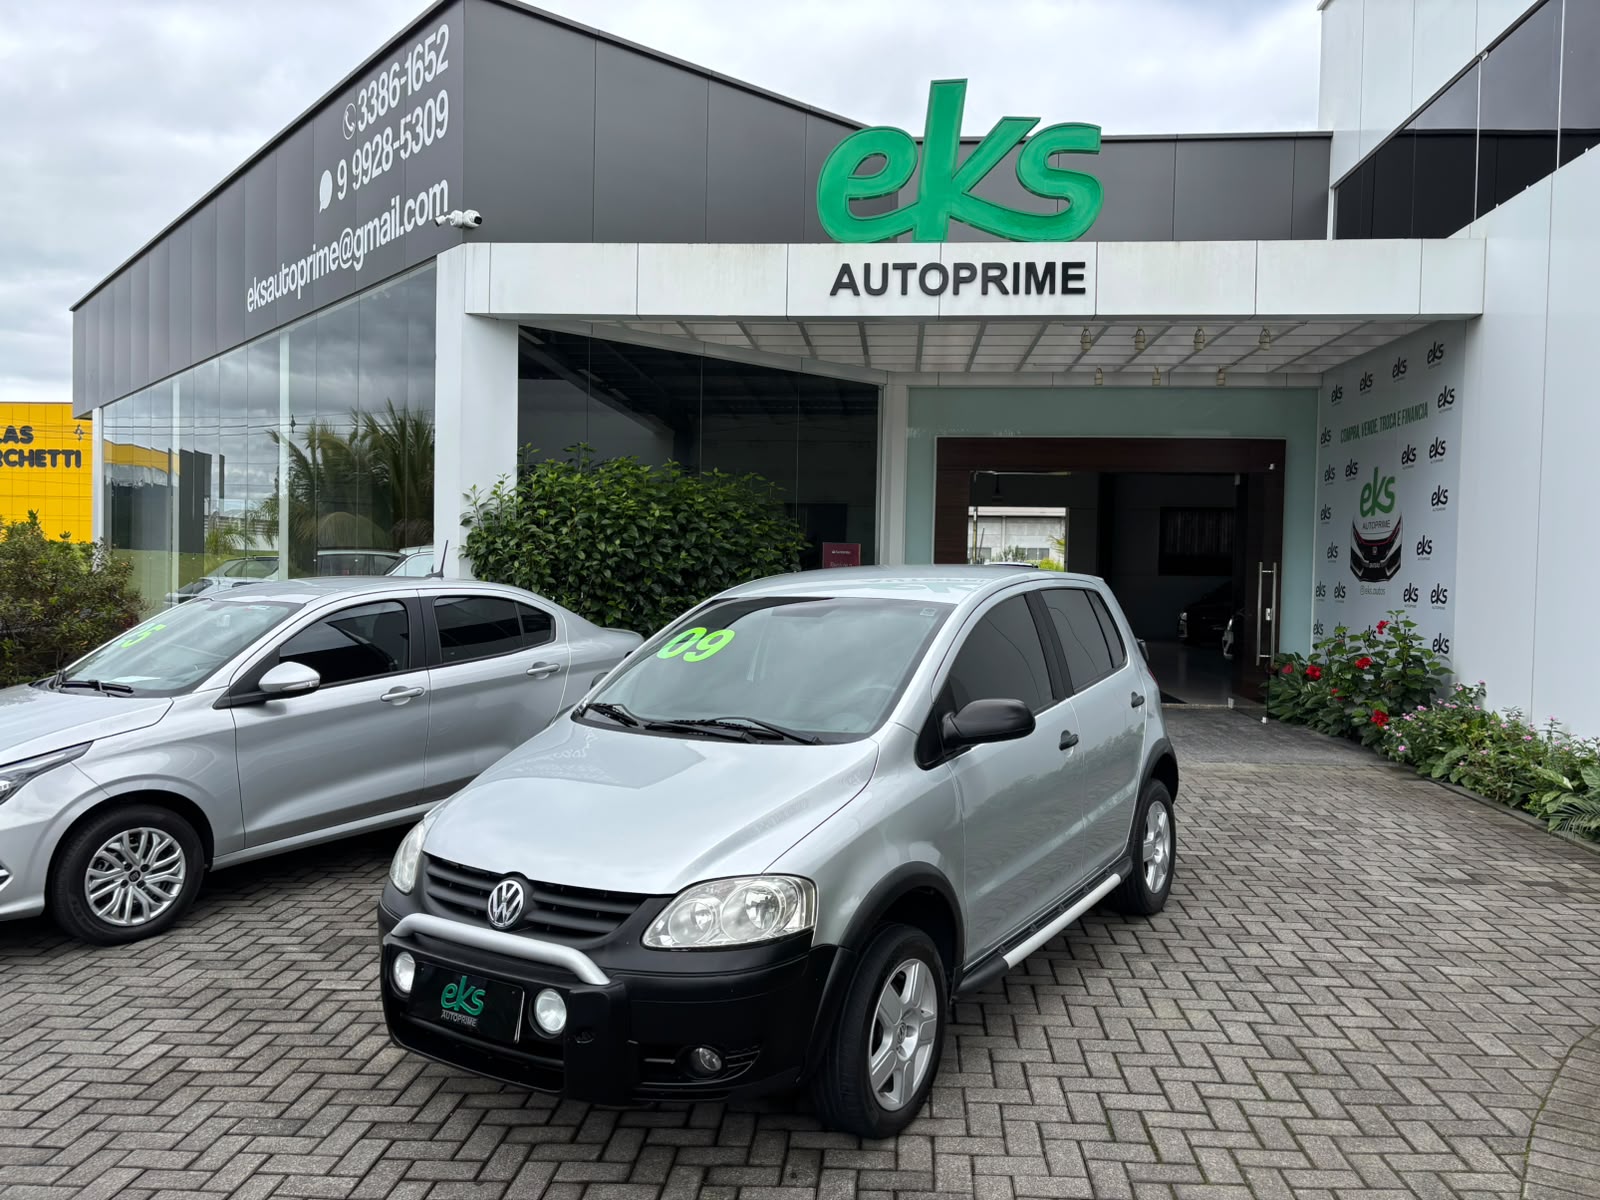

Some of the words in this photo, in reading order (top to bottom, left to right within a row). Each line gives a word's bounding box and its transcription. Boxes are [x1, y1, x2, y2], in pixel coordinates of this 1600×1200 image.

[357, 23, 449, 133] 3386-1652
[336, 158, 348, 201] 9
[352, 89, 449, 190] 9928-5309
[816, 78, 1104, 243] eks
[247, 179, 449, 313] eksautoprime@gmail.com
[829, 261, 1086, 296] AUTOPRIME
[1427, 341, 1444, 364] eks
[1392, 357, 1407, 378] eks
[1359, 371, 1373, 392] eks
[1331, 384, 1343, 403] eks
[1437, 385, 1455, 408] eks
[1380, 412, 1396, 432] TROCA
[1397, 410, 1402, 427] E
[1402, 402, 1428, 424] FINANCIA
[0, 448, 81, 468] CHETTI
[1401, 444, 1417, 465] eks
[1429, 436, 1446, 459] eks
[1345, 458, 1358, 477] eks
[1360, 466, 1395, 518] eks
[1431, 485, 1448, 507] eks
[1362, 520, 1391, 530] AUTOPRIME
[1416, 535, 1432, 556] eks
[1334, 581, 1346, 599] eks
[1403, 582, 1418, 602] eks
[1430, 583, 1448, 604] eks
[656, 627, 736, 662] 09
[1432, 633, 1450, 654] eks
[441, 975, 486, 1016] eks
[440, 1009, 478, 1027] AUTOPRIME
